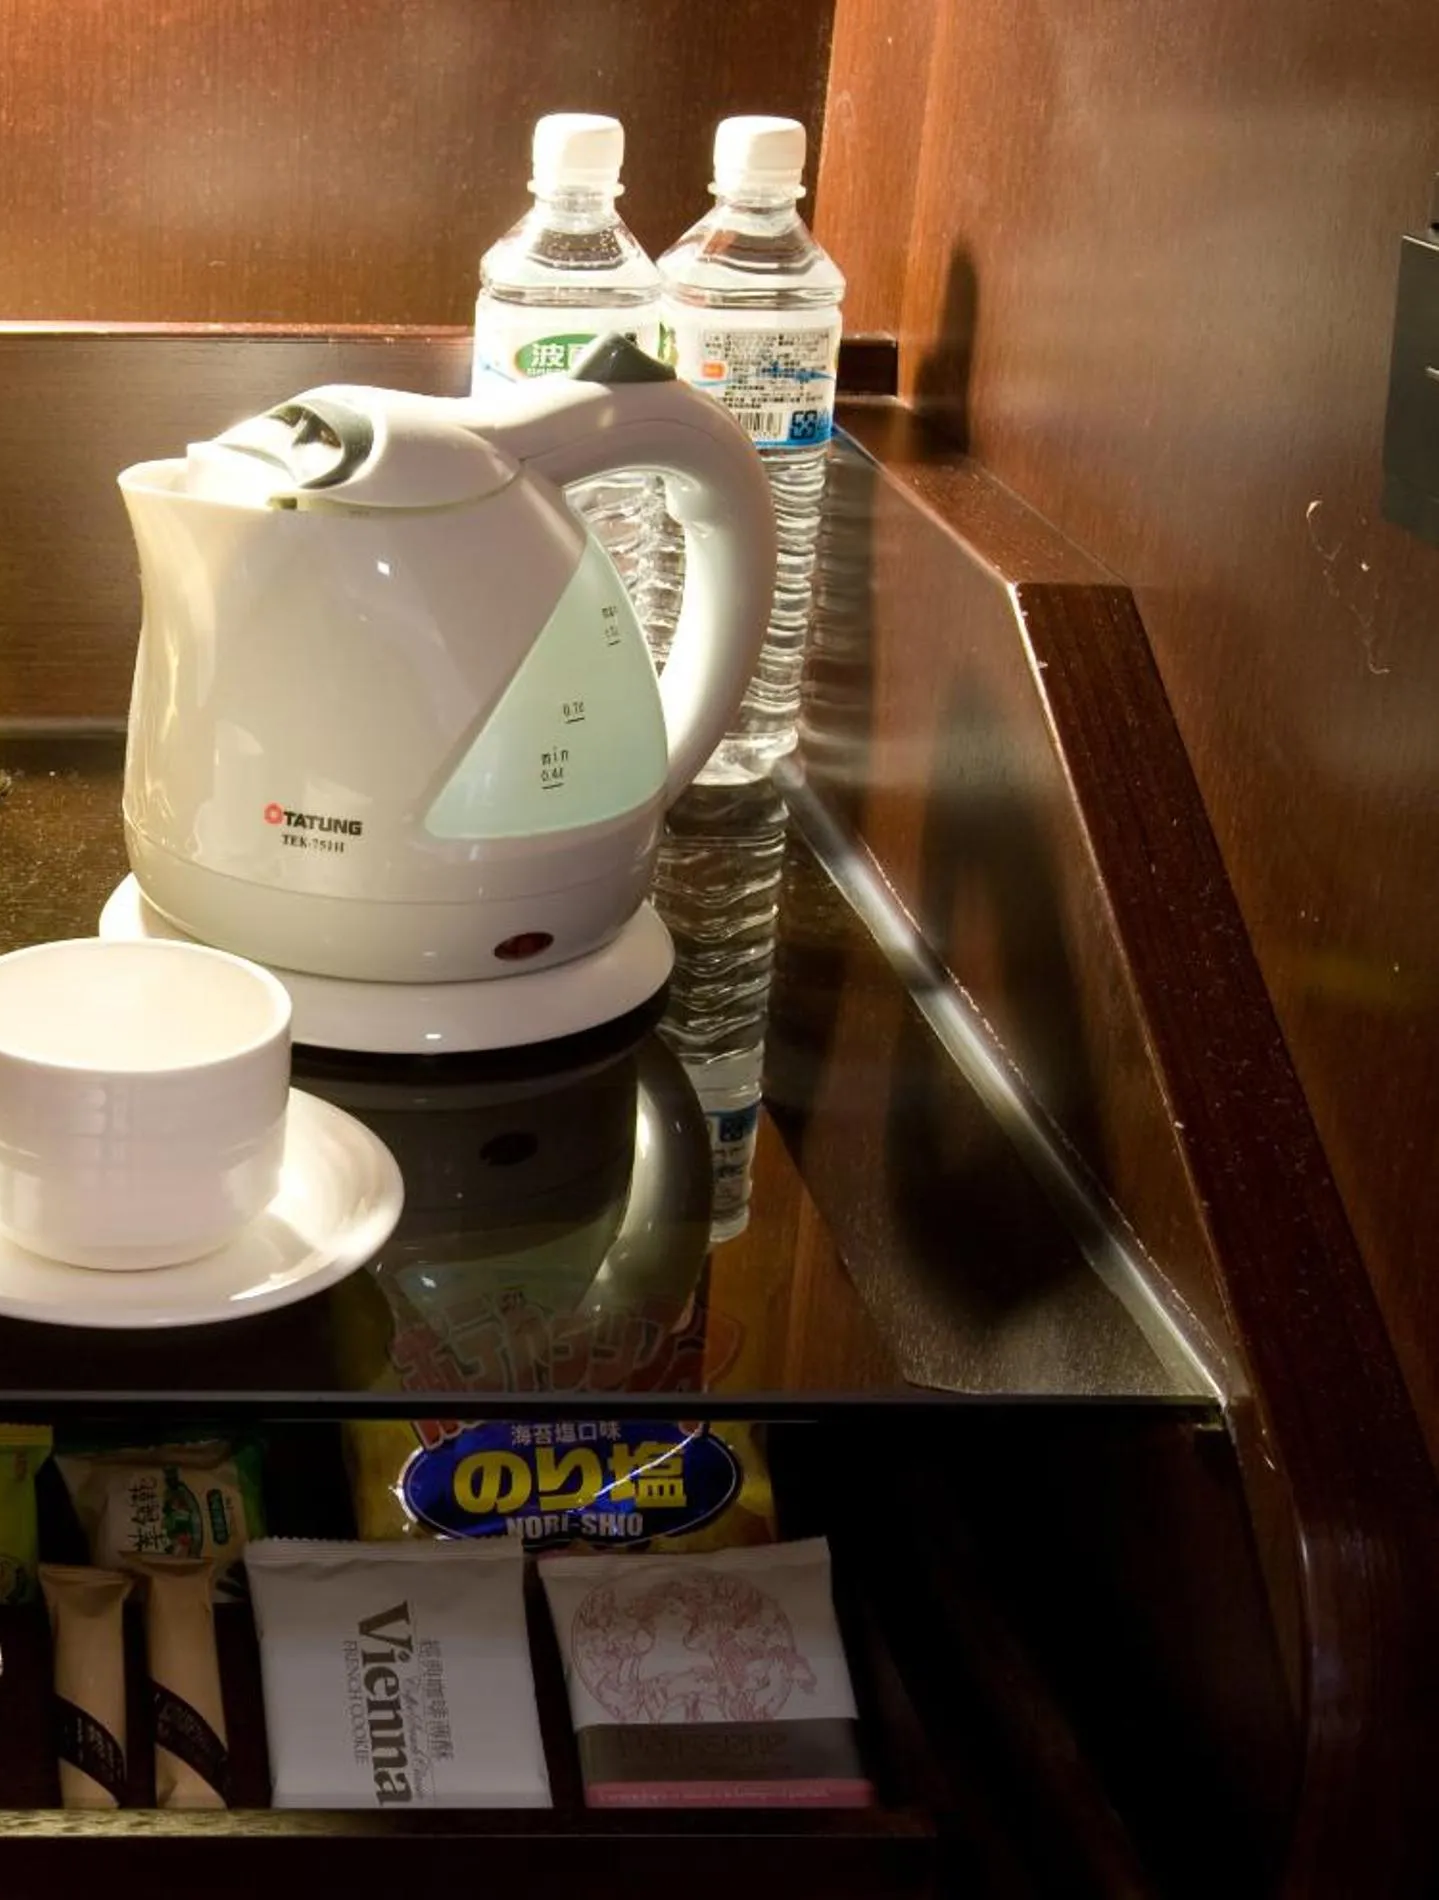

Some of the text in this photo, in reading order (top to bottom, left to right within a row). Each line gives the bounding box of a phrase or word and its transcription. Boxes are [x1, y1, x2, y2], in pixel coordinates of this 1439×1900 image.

[541, 746, 569, 766] min
[283, 810, 363, 836] TATUNG
[452, 1442, 687, 1516] のり塩
[505, 1511, 644, 1540] NORI-SHIO
[343, 1640, 371, 1768] FRENCH COOKIE
[357, 1600, 414, 1806] Vienna
